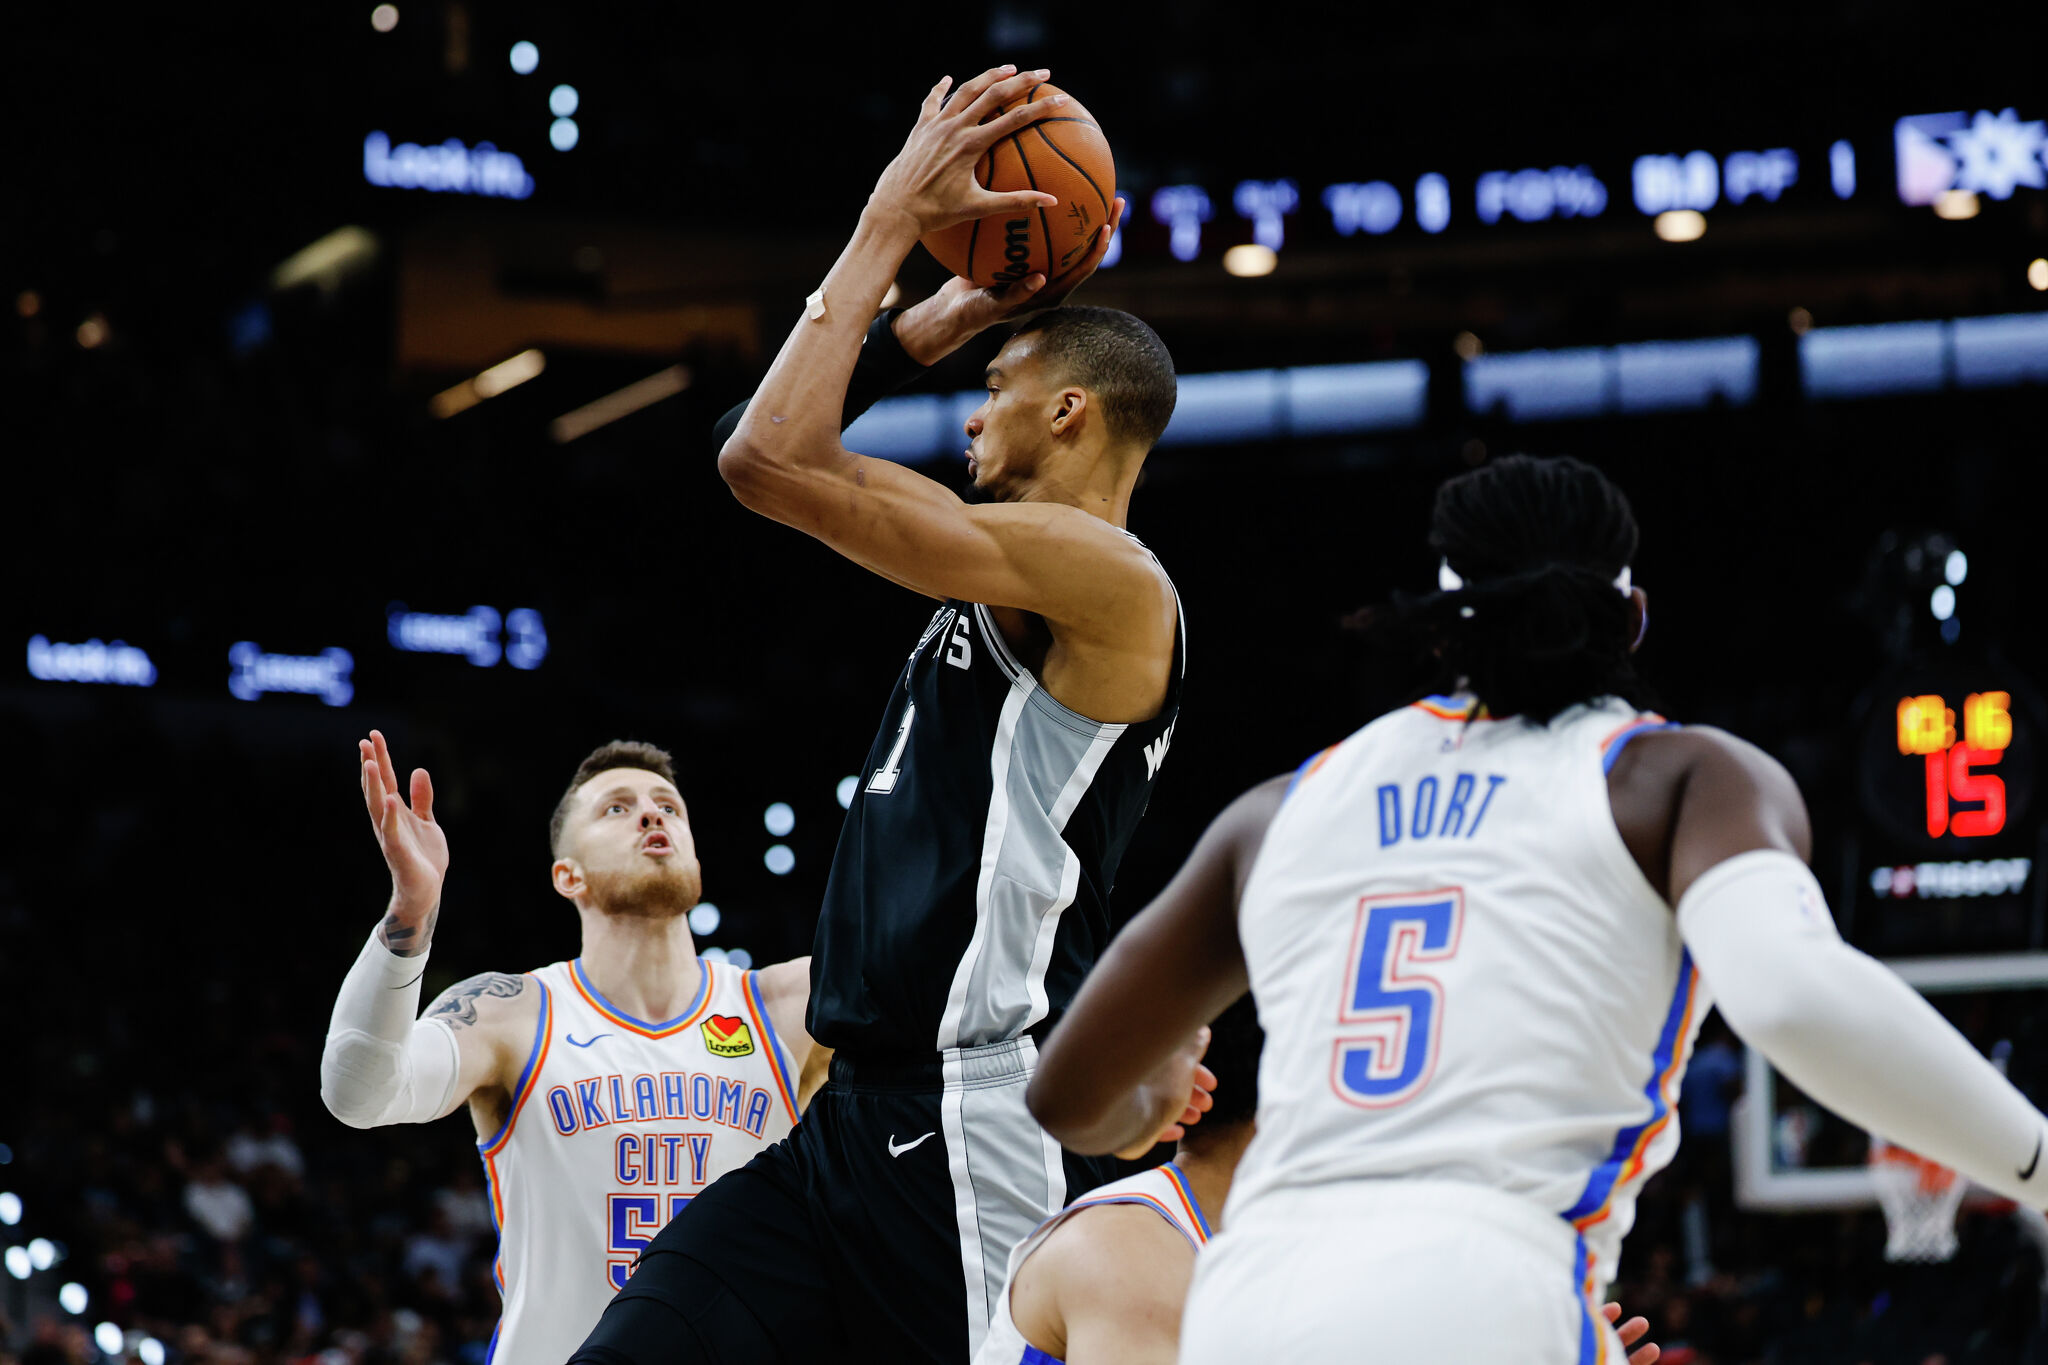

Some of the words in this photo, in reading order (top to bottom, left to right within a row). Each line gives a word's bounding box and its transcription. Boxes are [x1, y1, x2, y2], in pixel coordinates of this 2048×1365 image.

[864, 701, 916, 795] 1
[1925, 740, 2007, 839] 15
[1377, 772, 1507, 849] DORT
[1329, 886, 1465, 1110] 5
[547, 1072, 772, 1139] OKLAHOMA
[615, 1133, 712, 1186] CITY
[607, 1193, 700, 1292] 5
